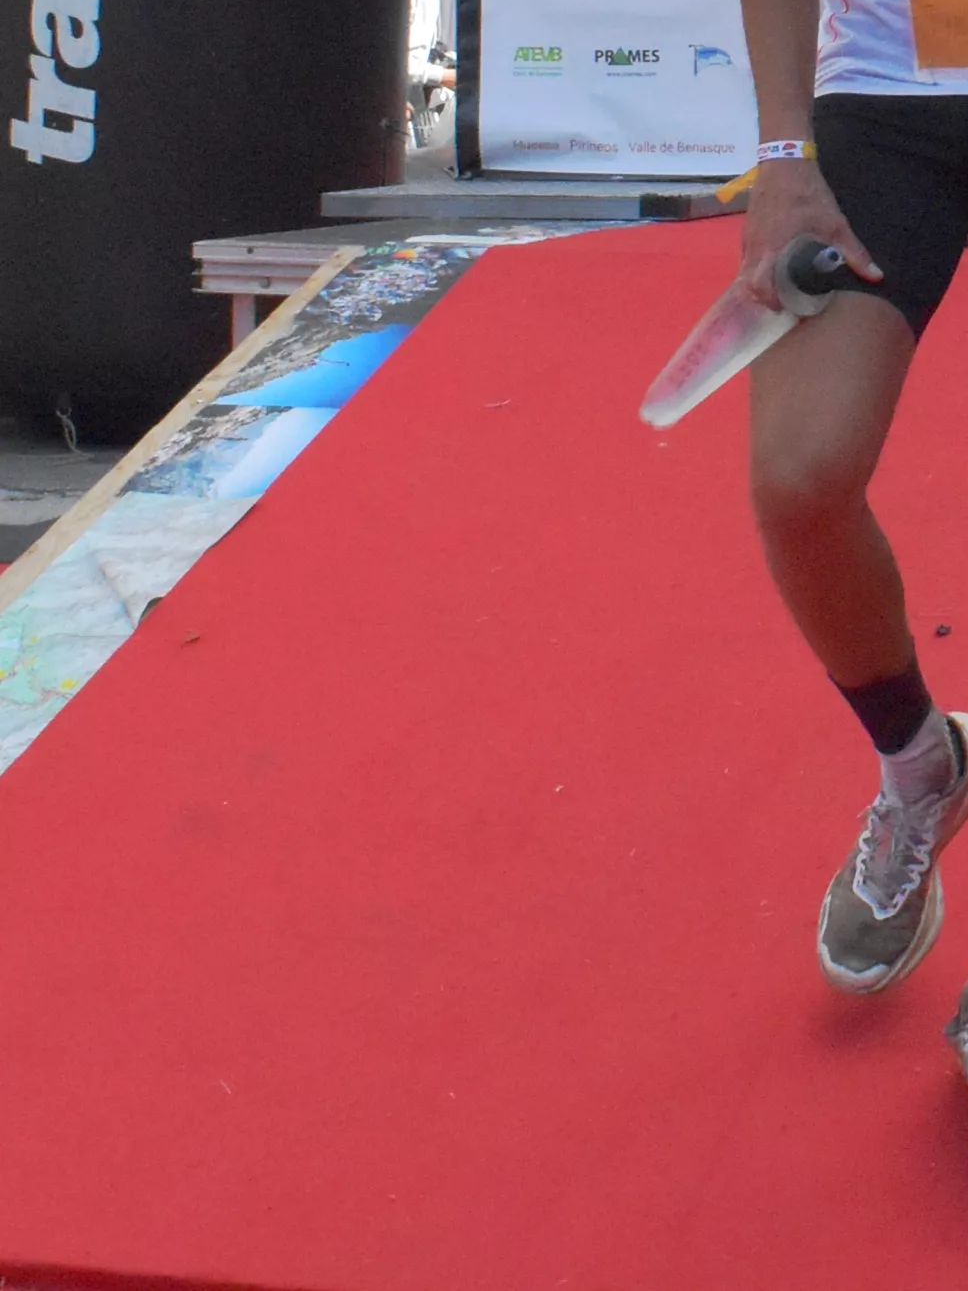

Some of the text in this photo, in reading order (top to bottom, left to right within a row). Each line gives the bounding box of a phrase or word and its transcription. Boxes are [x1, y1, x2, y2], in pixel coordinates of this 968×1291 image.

[595, 46, 660, 66] PRAMES
[570, 139, 619, 153] Pirineos
[628, 140, 657, 153] Valle
[660, 140, 674, 153] de
[677, 141, 735, 155] Benasque
